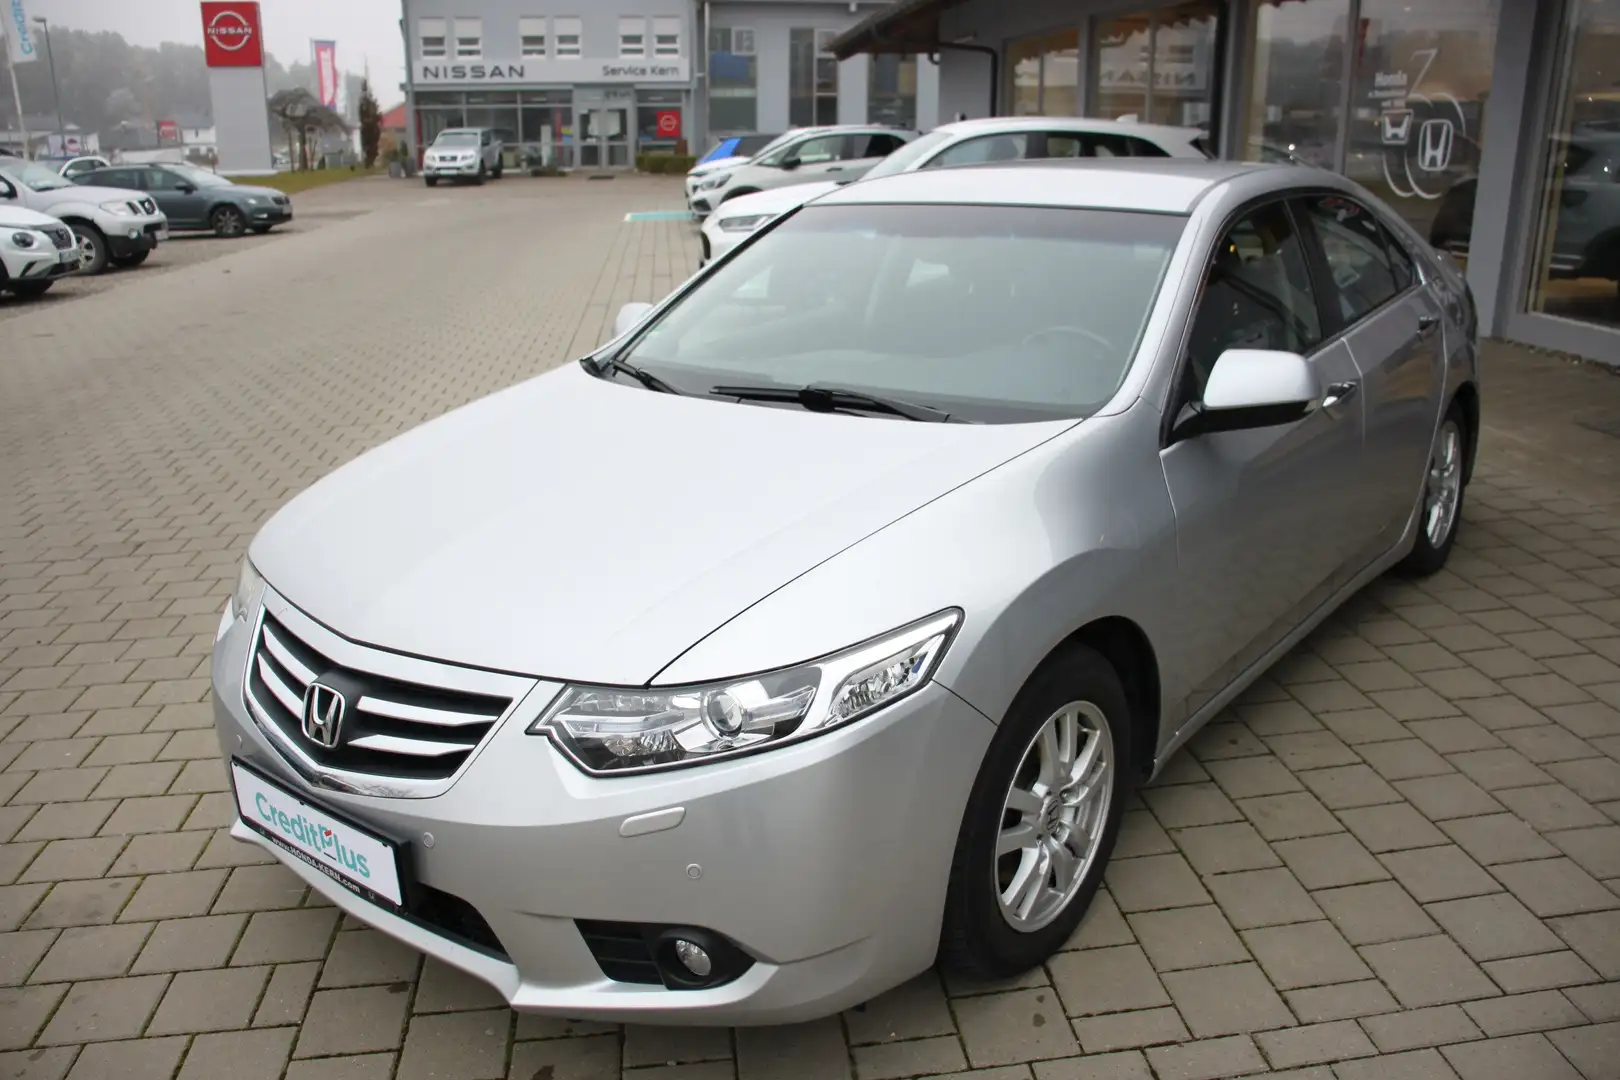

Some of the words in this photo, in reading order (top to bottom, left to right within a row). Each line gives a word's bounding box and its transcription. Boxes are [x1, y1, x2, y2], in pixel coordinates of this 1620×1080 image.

[207, 26, 252, 36] NISSAN
[422, 65, 525, 79] NISSAN
[602, 65, 647, 77] Service
[255, 792, 371, 879] CreditPlus
